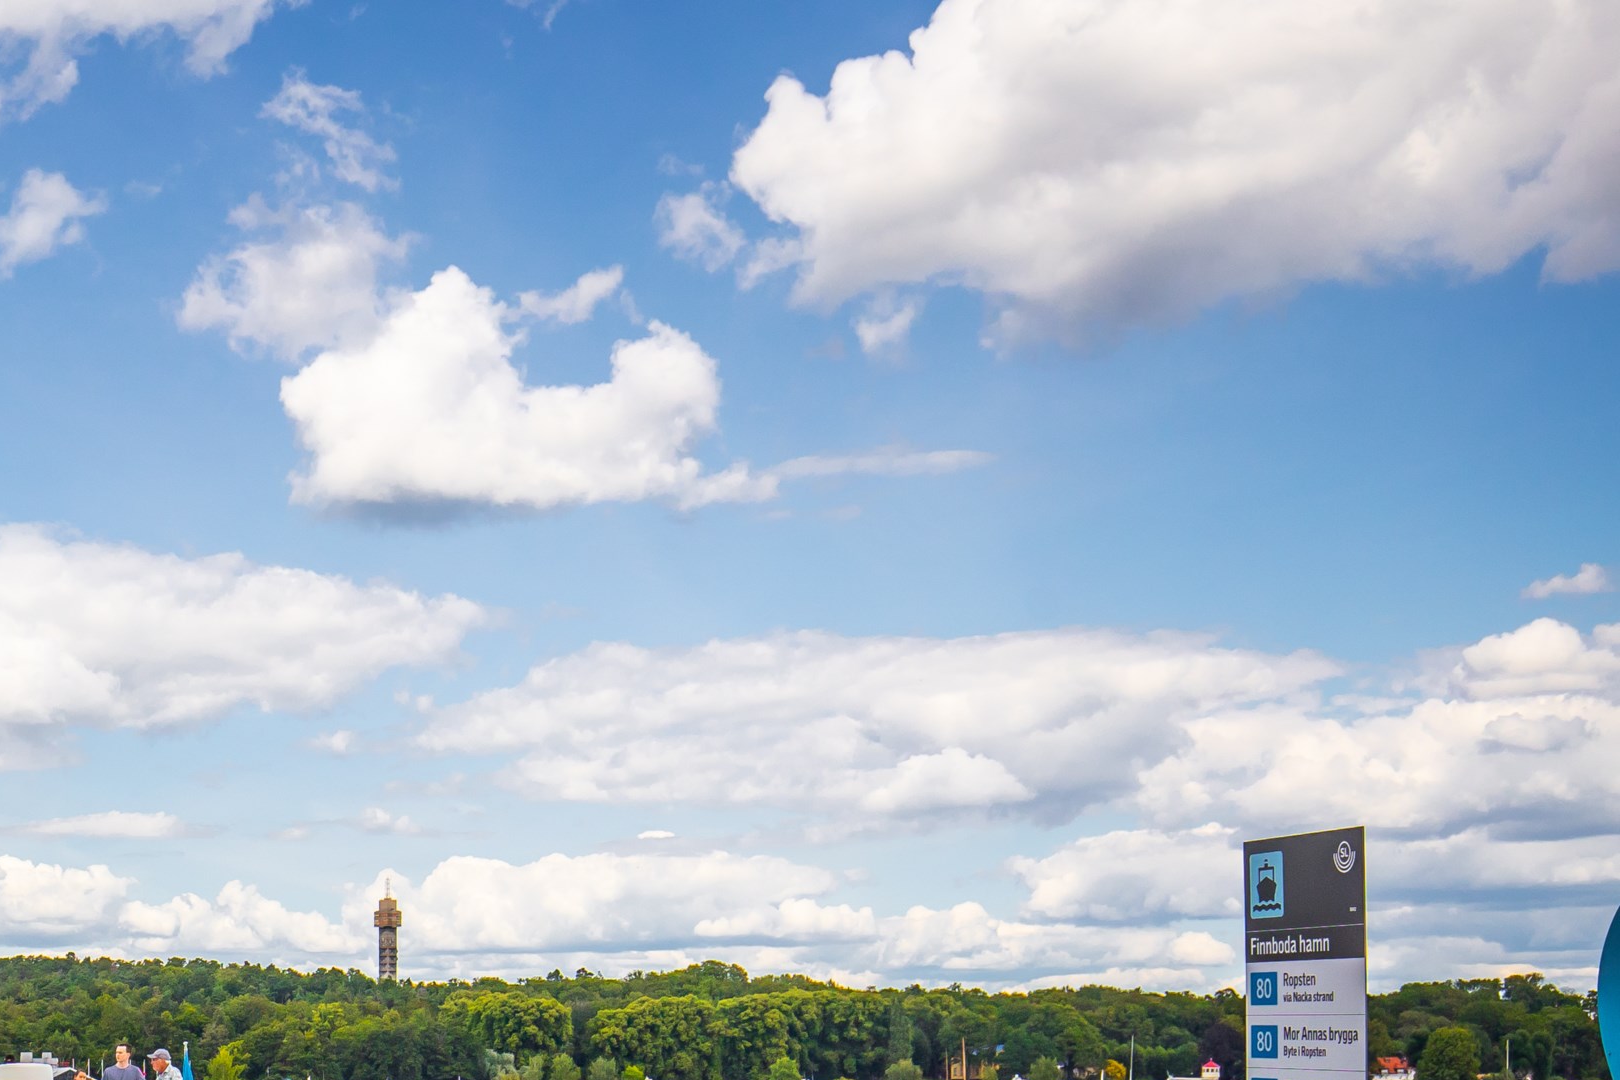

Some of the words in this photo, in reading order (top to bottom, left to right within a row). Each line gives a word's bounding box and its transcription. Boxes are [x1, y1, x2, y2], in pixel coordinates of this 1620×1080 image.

[1340, 848, 1349, 858] SL
[1250, 935, 1297, 956] Finnboda
[1299, 934, 1330, 952] hamn
[1256, 978, 1272, 999] 80
[1283, 972, 1316, 989] Ropsten
[1283, 992, 1292, 1002] via
[1293, 992, 1312, 1002] Nacka
[1313, 991, 1334, 1002] strand
[1256, 1031, 1272, 1052] 80
[1283, 1026, 1300, 1041] Mor
[1301, 1026, 1327, 1041] Annas
[1329, 1026, 1359, 1044] brygga
[1283, 1045, 1297, 1058] Byte
[1301, 1046, 1327, 1058] Ropsten
